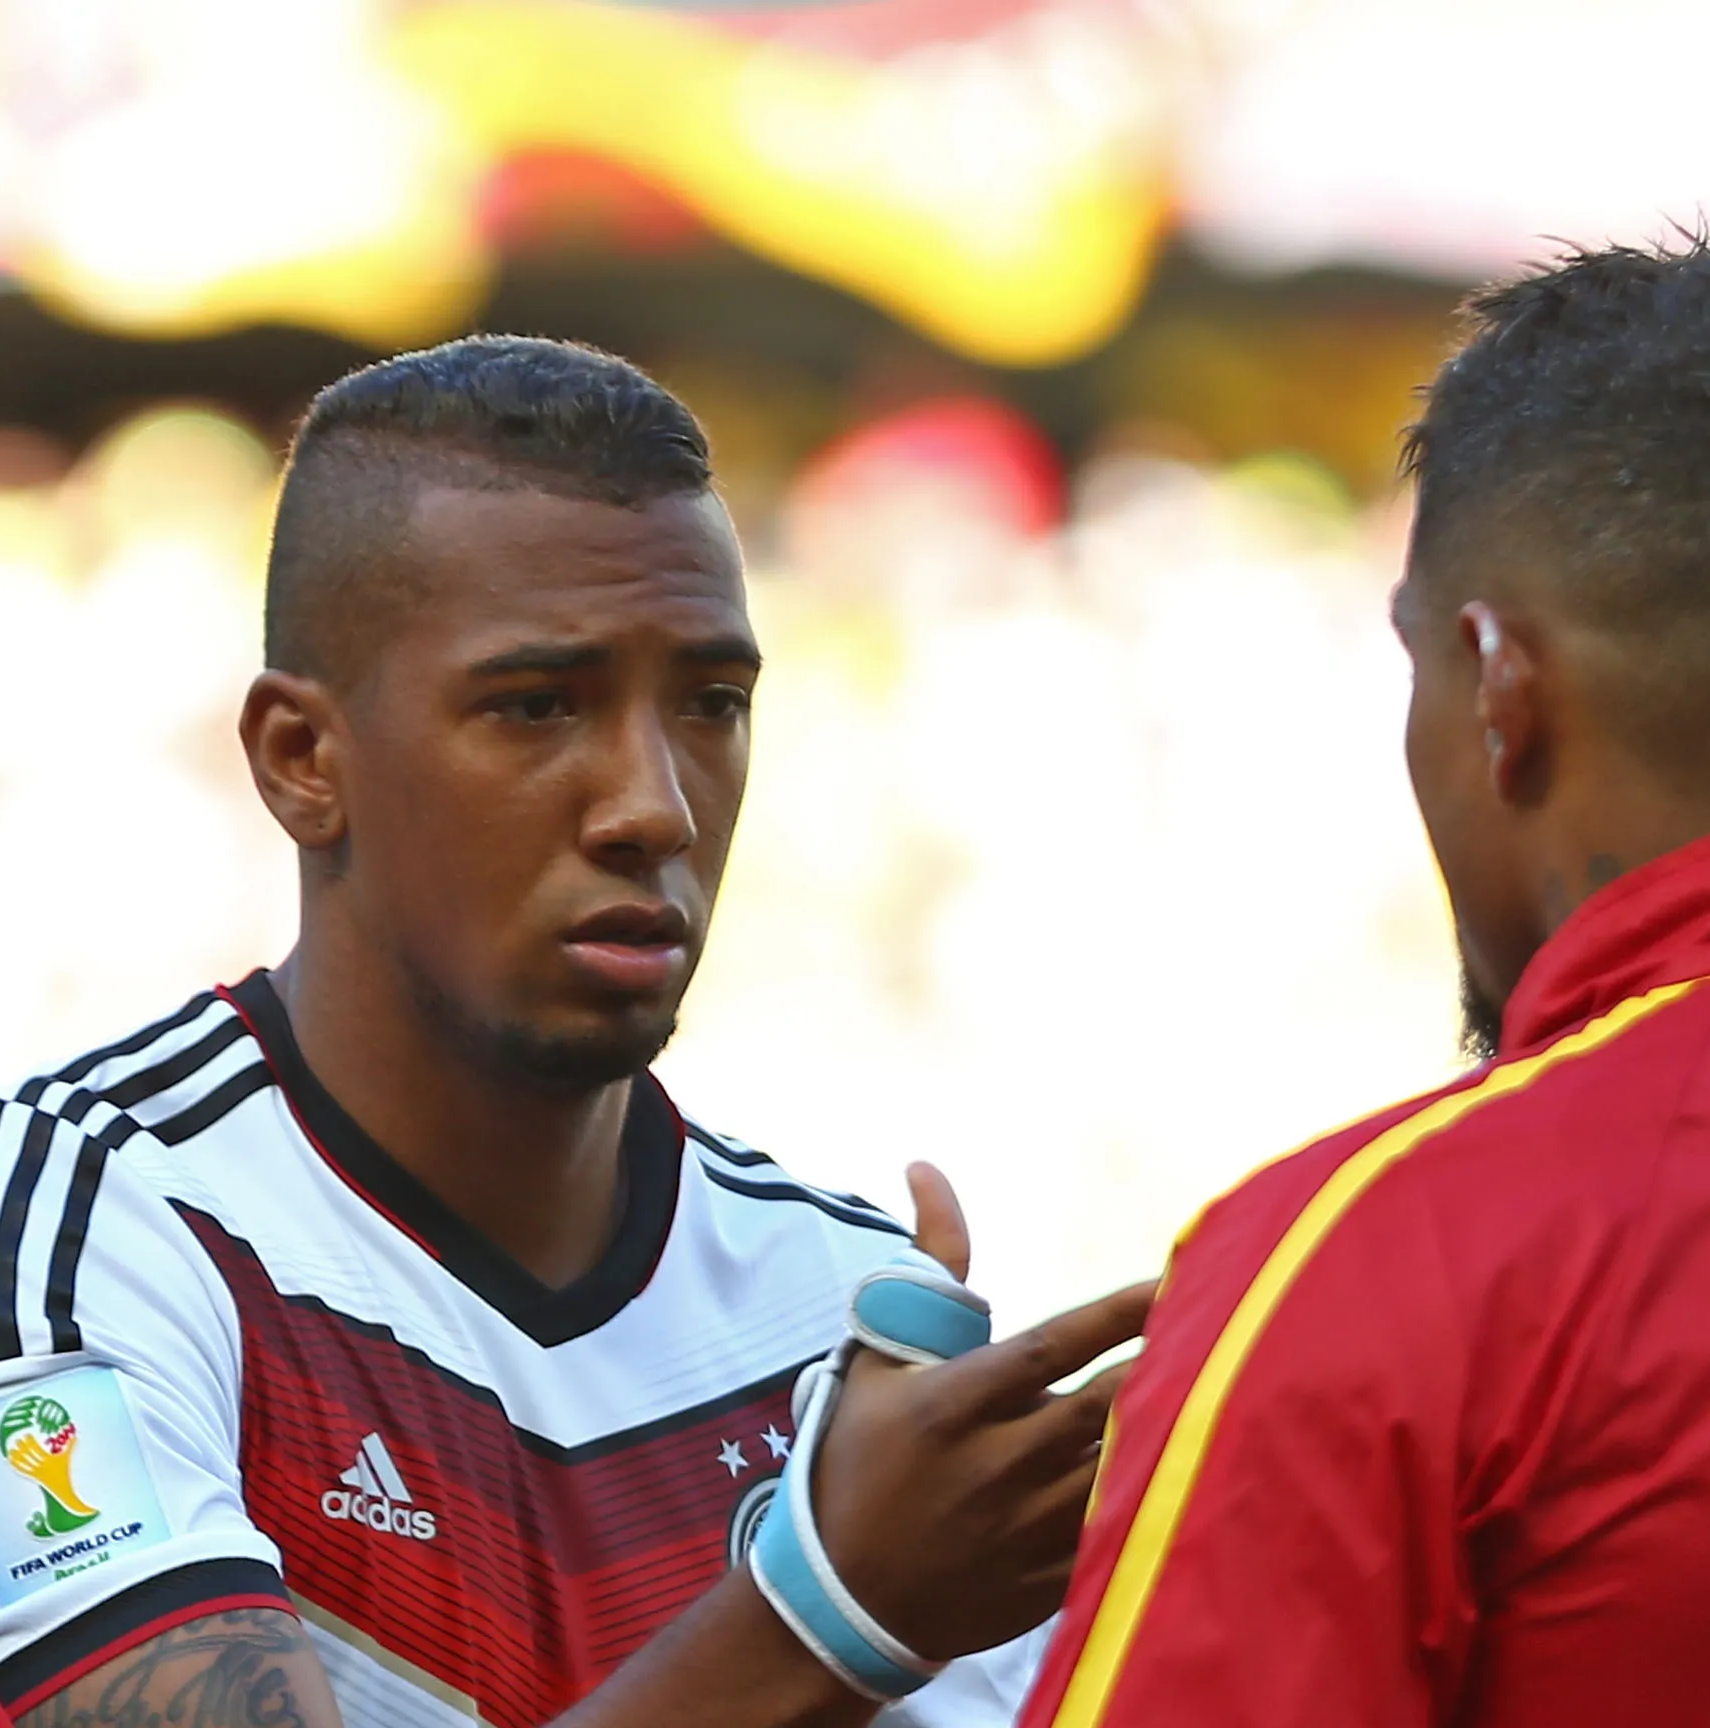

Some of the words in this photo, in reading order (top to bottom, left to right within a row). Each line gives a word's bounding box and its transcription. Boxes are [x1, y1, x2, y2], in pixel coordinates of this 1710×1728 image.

[320, 1489, 437, 1540] addas
[9, 1557, 47, 1580] FIFA
[46, 1533, 109, 1565] WORLD
[110, 1521, 143, 1541] CUP
